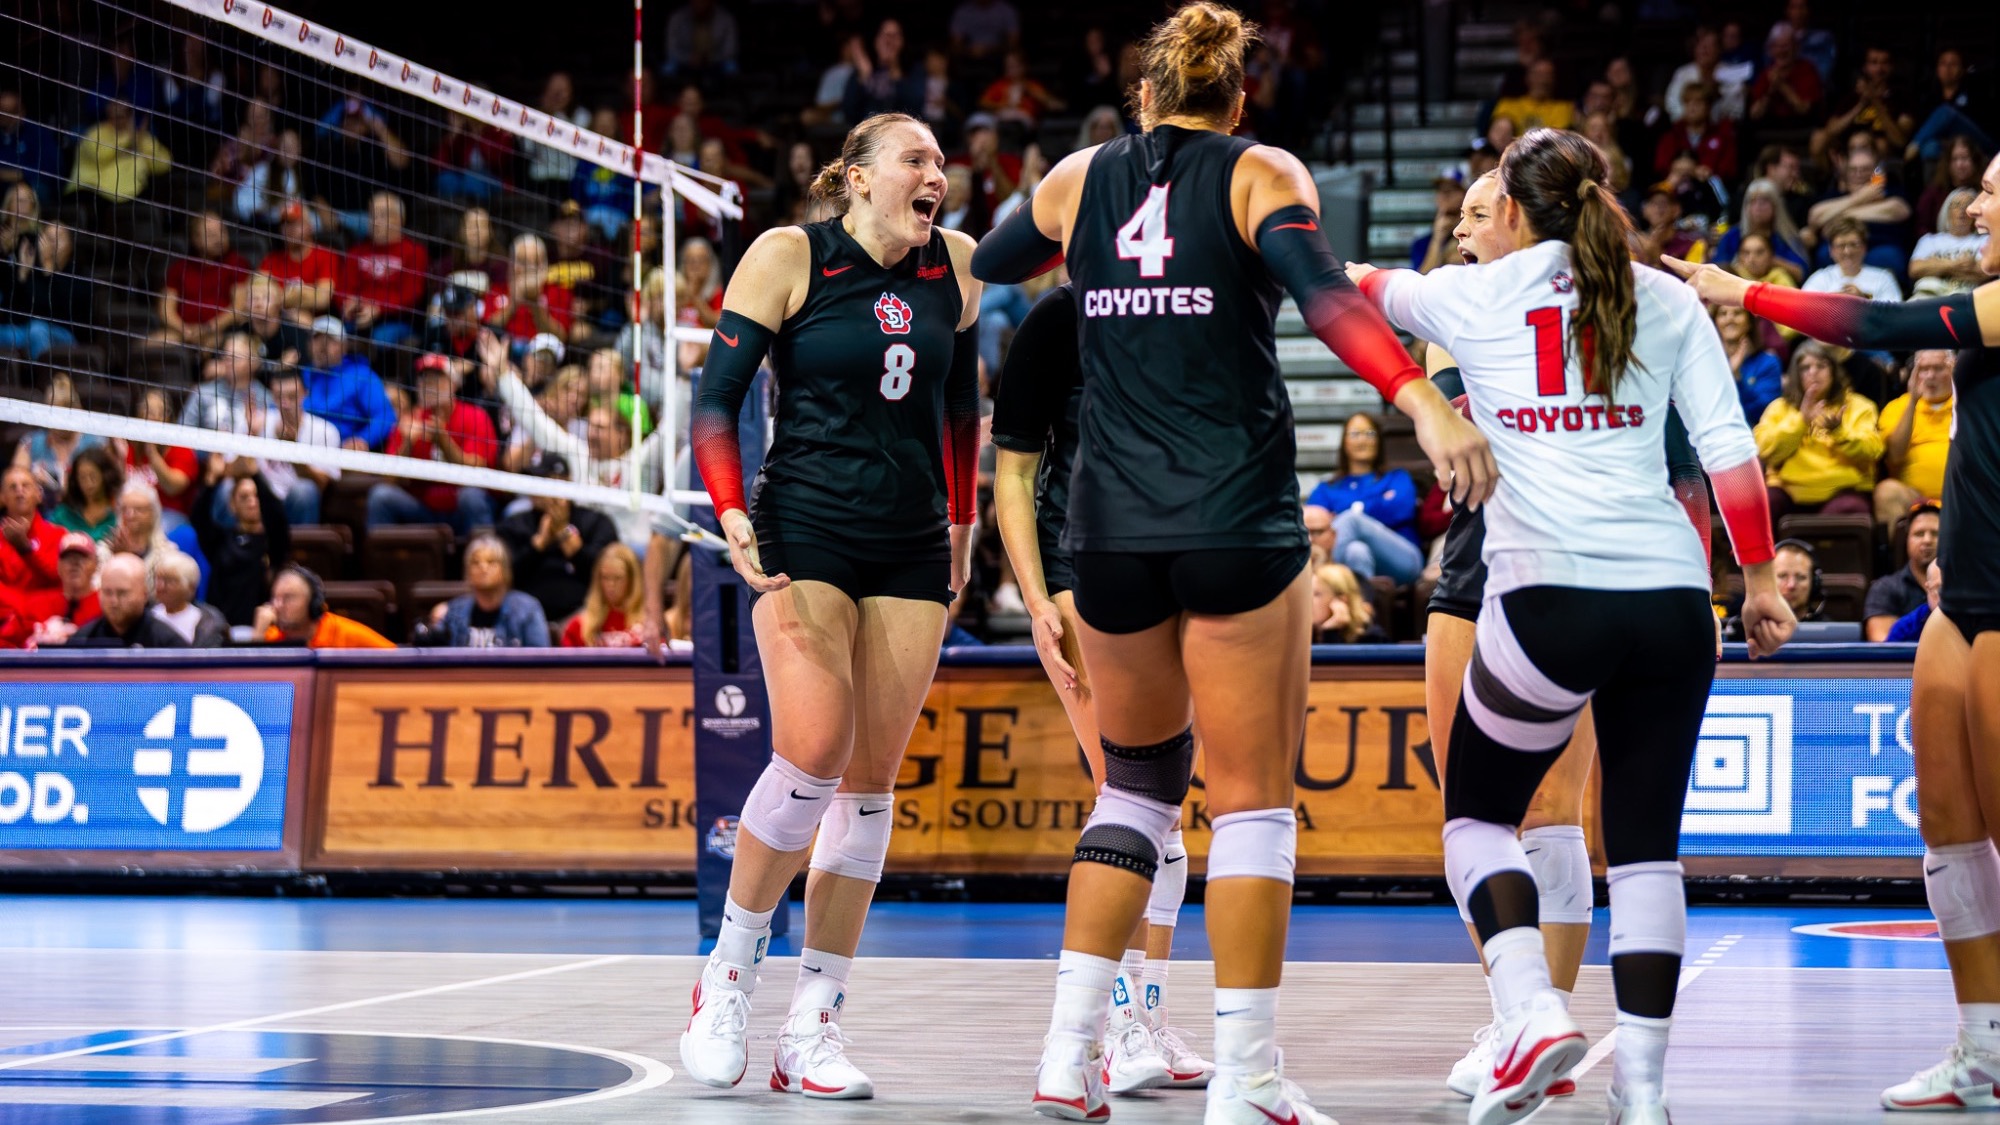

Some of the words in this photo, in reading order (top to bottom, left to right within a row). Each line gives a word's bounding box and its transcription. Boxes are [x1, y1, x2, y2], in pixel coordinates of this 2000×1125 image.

[1116, 180, 1175, 279] 4
[1085, 287, 1214, 318] COYOTES
[879, 343, 916, 401] 8
[1496, 404, 1645, 433] COYOTES
